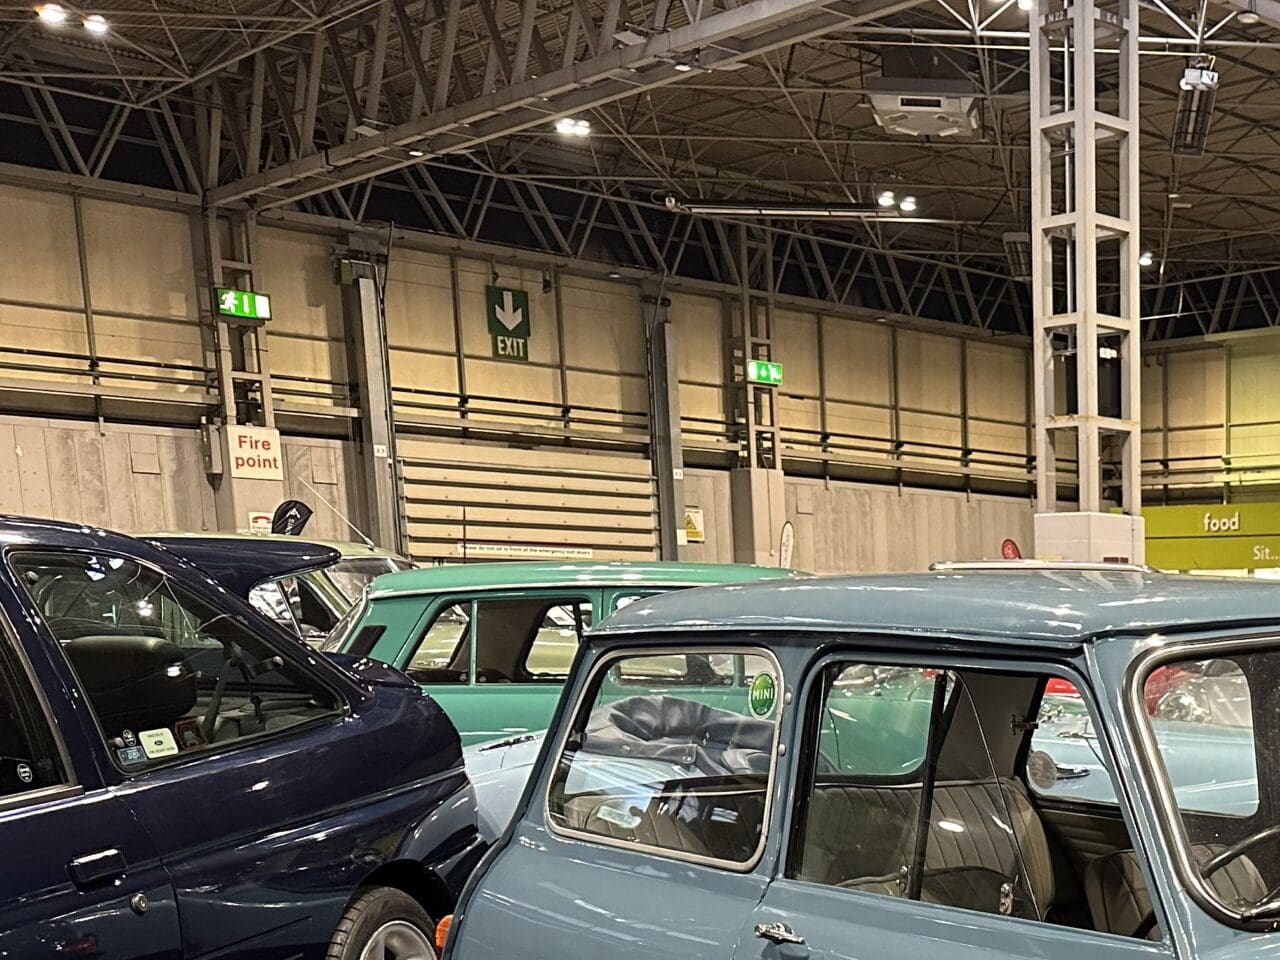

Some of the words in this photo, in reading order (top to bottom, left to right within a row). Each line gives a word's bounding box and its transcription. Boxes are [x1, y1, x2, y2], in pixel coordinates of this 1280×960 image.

[497, 336, 525, 357] EXIT
[238, 435, 271, 450] Fire
[235, 454, 279, 469] point
[1203, 512, 1240, 532] food
[752, 687, 774, 701] MINI
